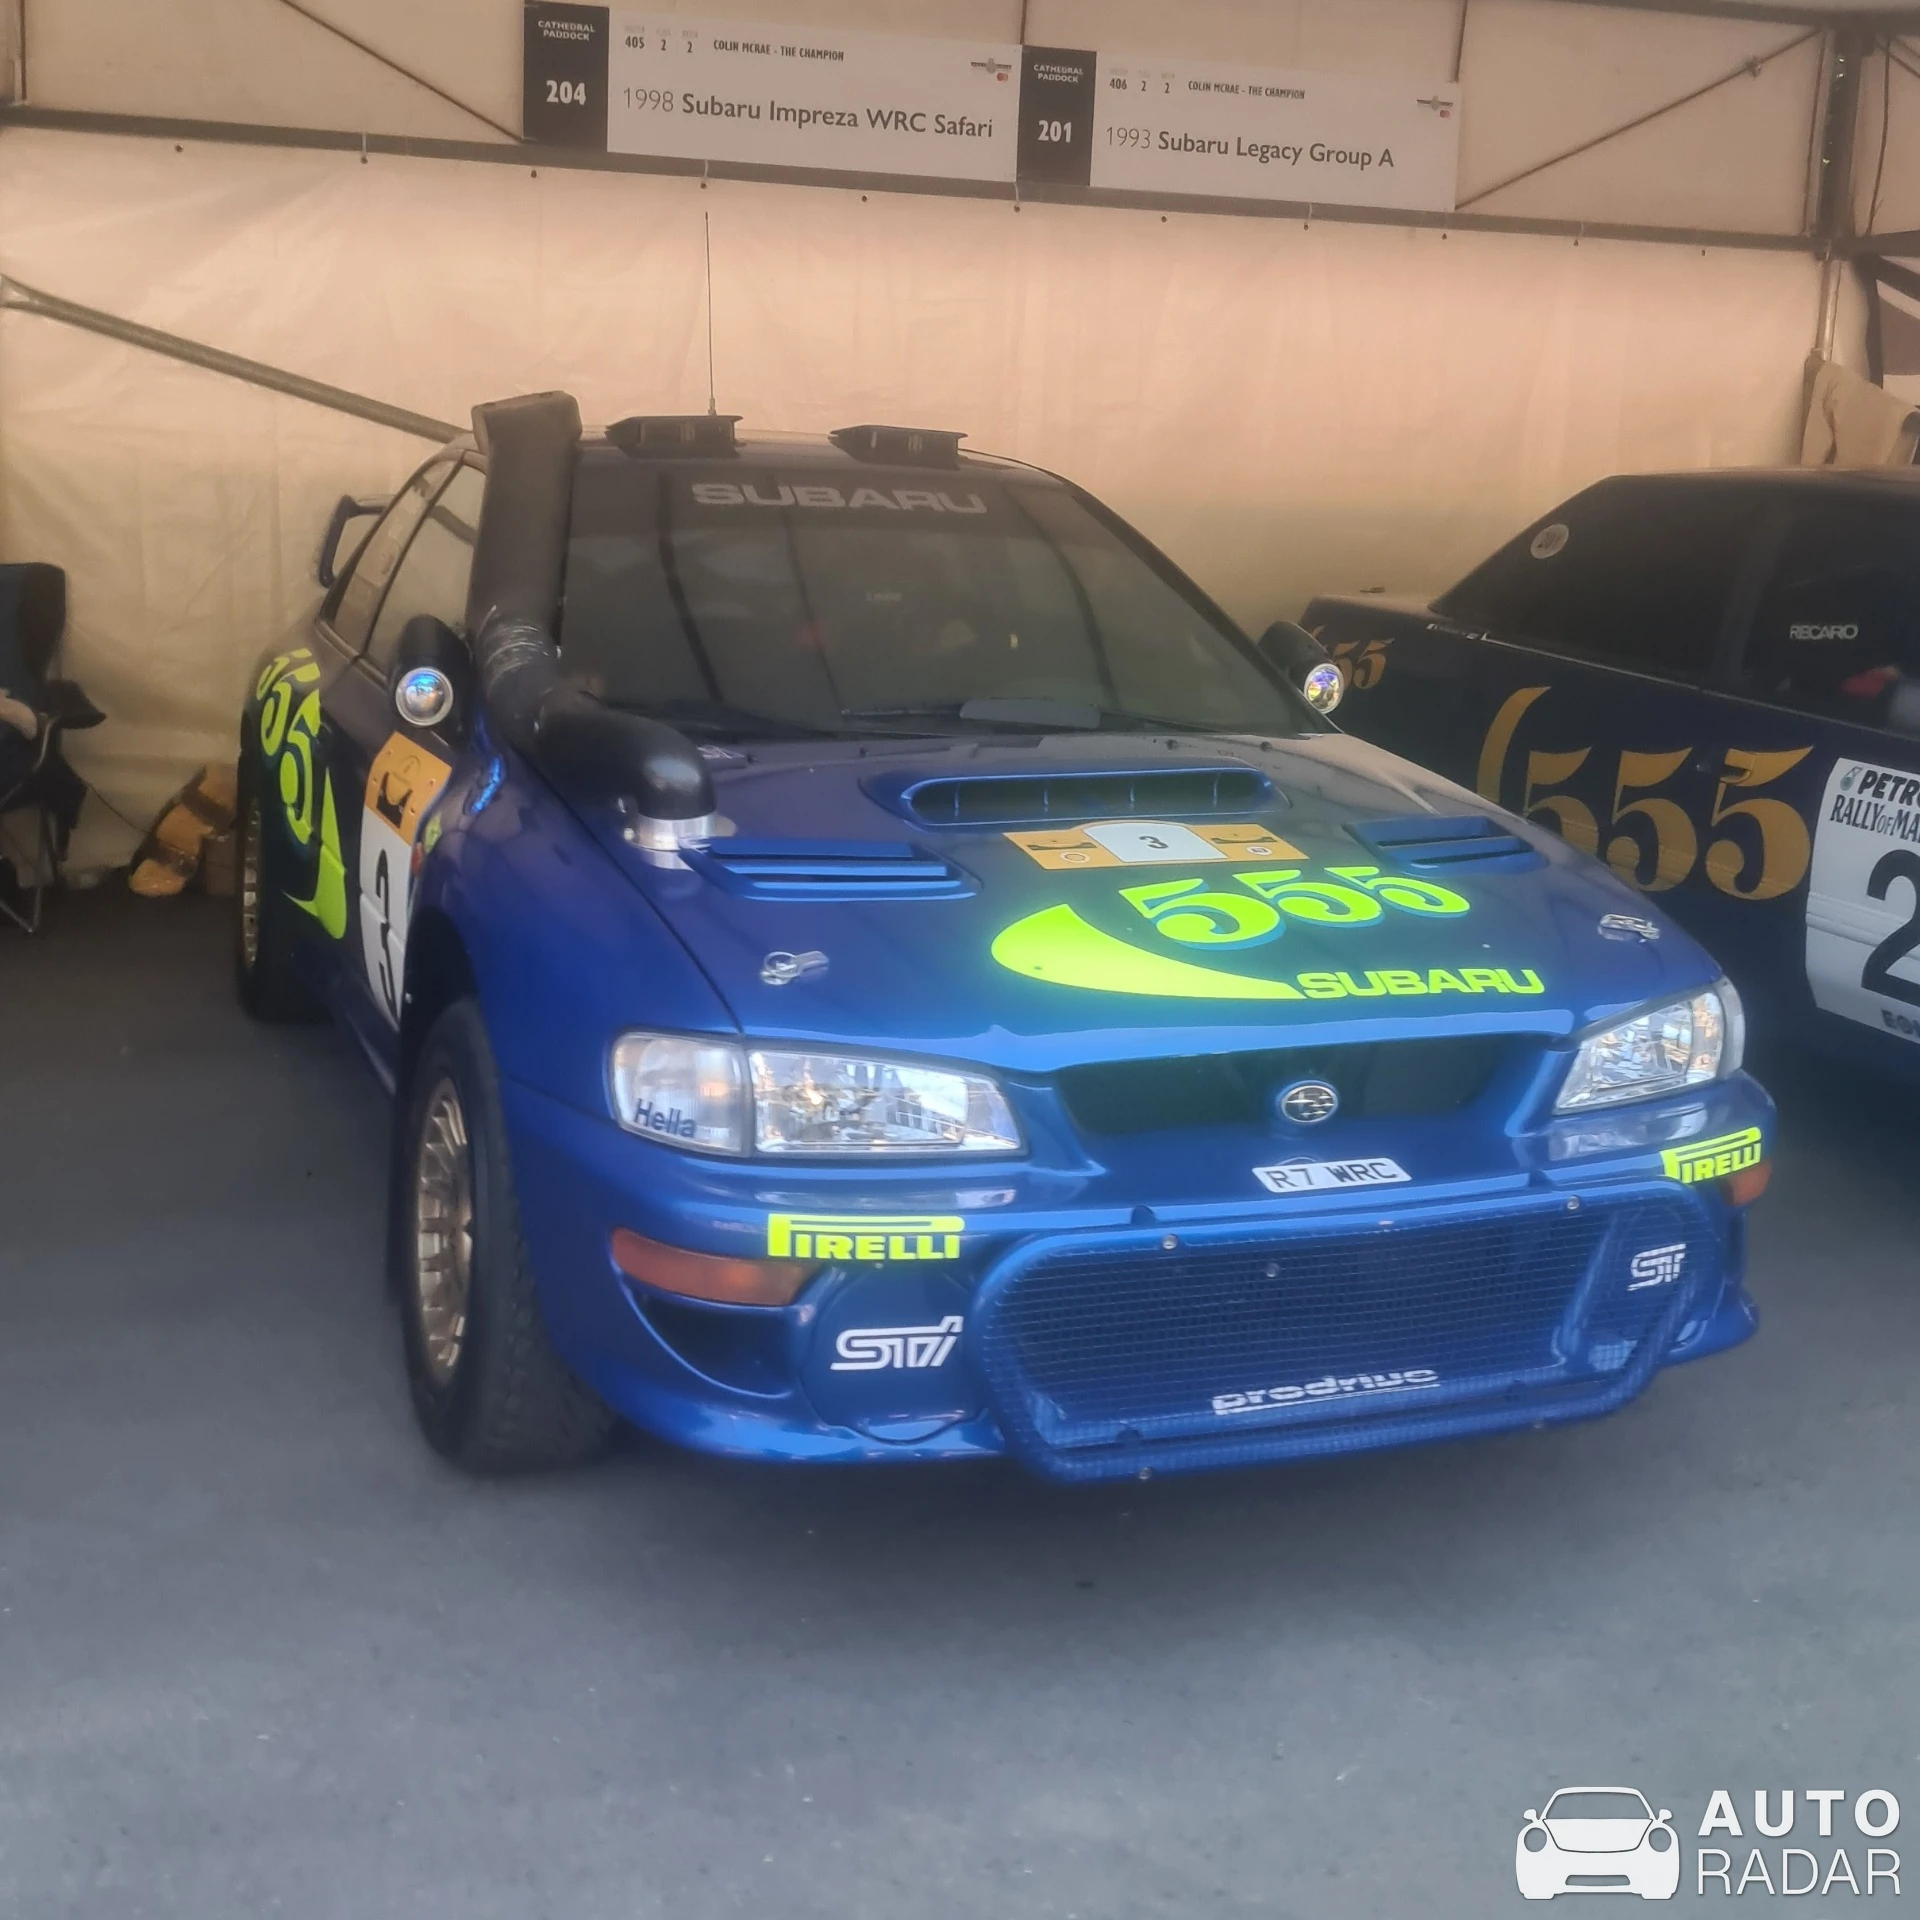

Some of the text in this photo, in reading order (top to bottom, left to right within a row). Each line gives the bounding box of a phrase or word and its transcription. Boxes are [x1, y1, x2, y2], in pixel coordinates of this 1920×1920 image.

[538, 19, 596, 33] CATHEDRAL
[543, 29, 590, 42] PADDOCK
[625, 36, 694, 54] 405 2 2
[713, 39, 739, 52] COLIN
[742, 42, 771, 55] MCRAE
[781, 45, 797, 58] THE
[799, 47, 845, 62] CHAMPION
[1033, 64, 1085, 76] CATHEDRAL
[1037, 72, 1079, 83] PADDOCK
[545, 79, 587, 105] 204
[1109, 77, 1171, 95] 406 2 2
[1188, 80, 1212, 93] COLIN
[1214, 82, 1240, 95] MCRAE
[1248, 85, 1263, 97] THE
[1265, 87, 1306, 100] CHAMPION
[623, 87, 993, 138] 1998 Subaru Impreza WRC Safari
[1037, 119, 1073, 143] 201
[1106, 126, 1395, 171] 1993 Subaru Legacy Group A
[691, 483, 988, 514] SUBARU
[1789, 624, 1859, 640] RECARO
[1857, 769, 1920, 808] PETR
[1522, 745, 1814, 900] 555
[1829, 794, 1886, 831] RALLY
[1889, 808, 1920, 844] MA
[1138, 835, 1169, 850] 3
[1118, 866, 1473, 947] 555
[375, 848, 401, 1020] 3
[1861, 848, 1920, 1010] 2
[1297, 969, 1545, 999] SUBARU
[633, 1098, 697, 1139] Hella
[1659, 1126, 1762, 1184] PIRELLI
[1264, 1161, 1399, 1189] R7 WRC
[767, 1213, 966, 1260] PIRELLI
[1211, 1369, 1439, 1415] prodrive
